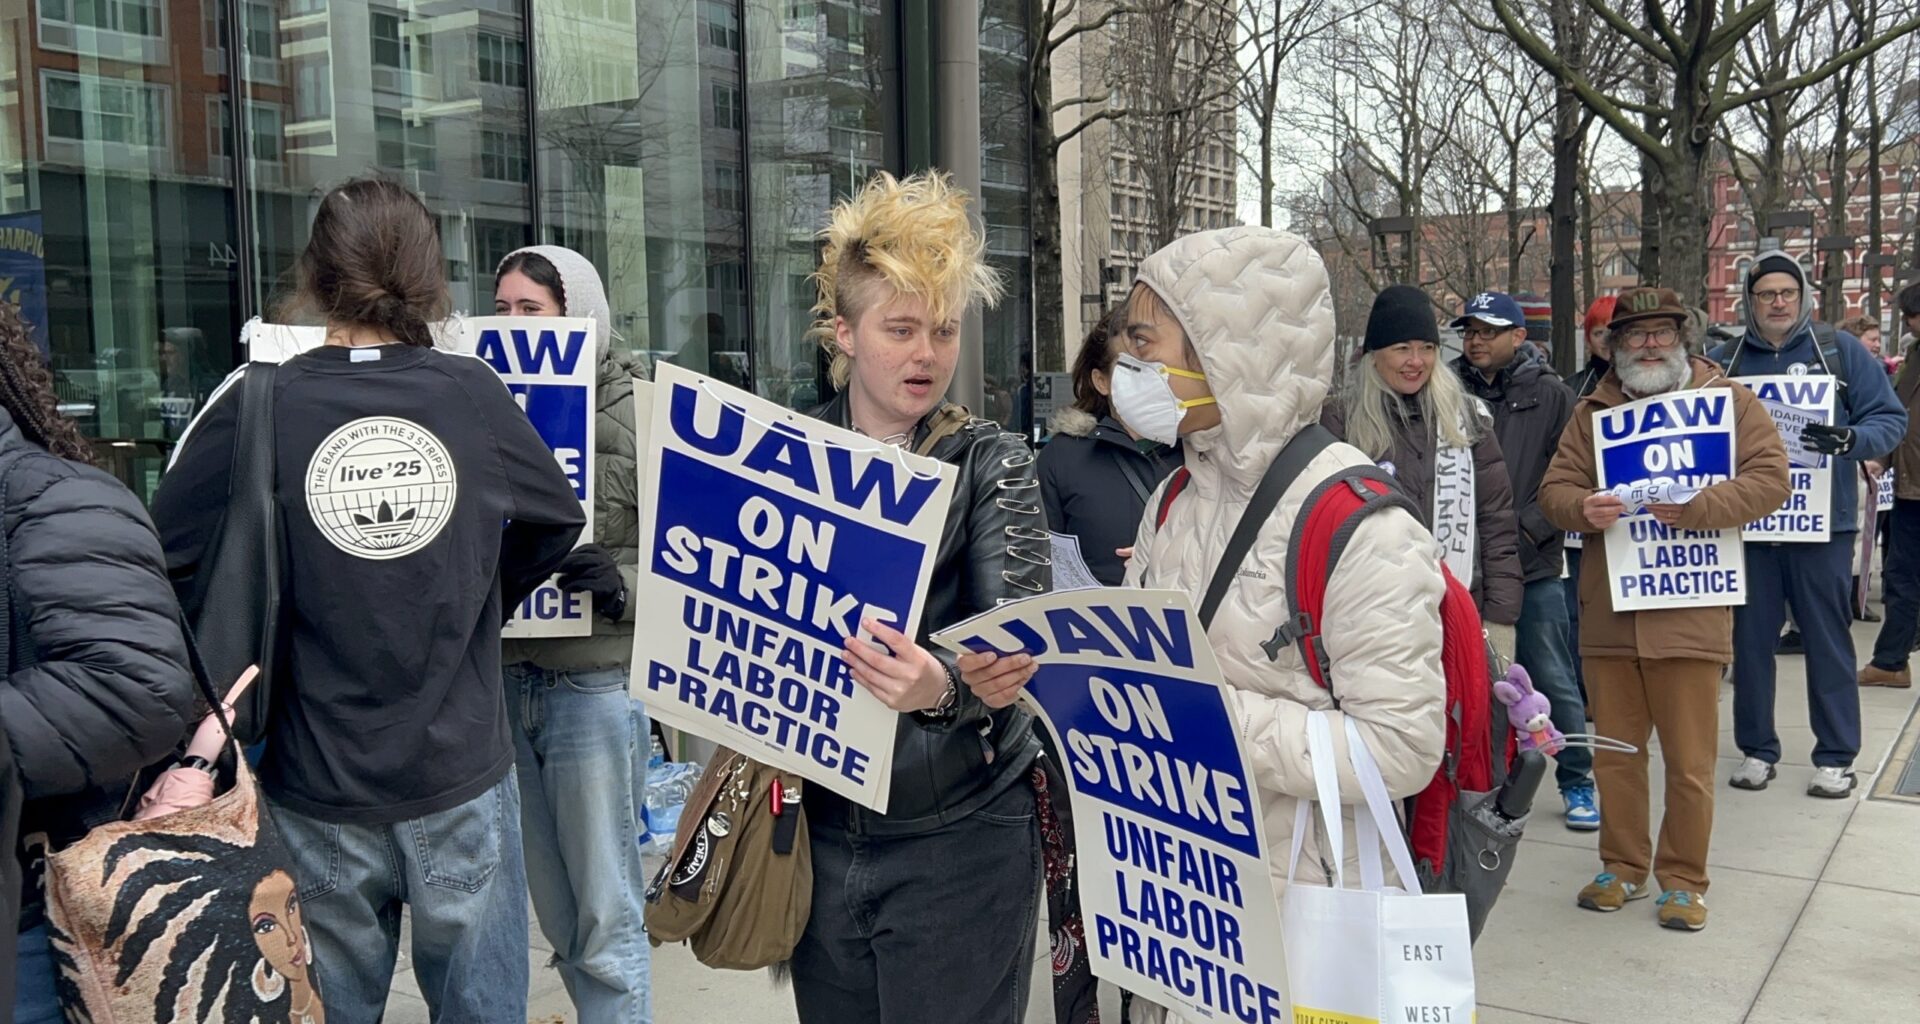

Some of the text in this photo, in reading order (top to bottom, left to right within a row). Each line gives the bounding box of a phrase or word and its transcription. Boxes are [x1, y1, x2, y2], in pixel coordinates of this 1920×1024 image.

[0, 227, 44, 258] HAMPIO
[475, 329, 588, 375] AW
[1601, 396, 1727, 441] UAW
[1744, 382, 1830, 404] AW
[1770, 408, 1821, 425] IDARITY
[315, 425, 448, 489] THE BAND WITH THE 3 STRIPES
[340, 466, 384, 482] live
[670, 383, 942, 526] UAW
[1643, 439, 1695, 472] ON
[1436, 436, 1457, 560] CONTRA
[1743, 514, 1824, 532] ACTICE
[738, 496, 836, 573] ON
[1638, 543, 1719, 569] LABOR
[661, 525, 898, 654] STRIKE
[1620, 570, 1738, 598] PRACTICE
[683, 595, 855, 699] UNFAIR
[958, 606, 1194, 669] UAW
[687, 637, 841, 732] LABOR
[1088, 676, 1174, 743] ON
[648, 660, 870, 786] PRACTICE
[1067, 728, 1250, 836] STRIKE
[1103, 811, 1244, 909] UNFAIR
[1116, 871, 1245, 966] LABOR
[1095, 914, 1281, 1024] PRACTICE
[1403, 944, 1444, 962] EAST
[1405, 1006, 1452, 1023] WEST
